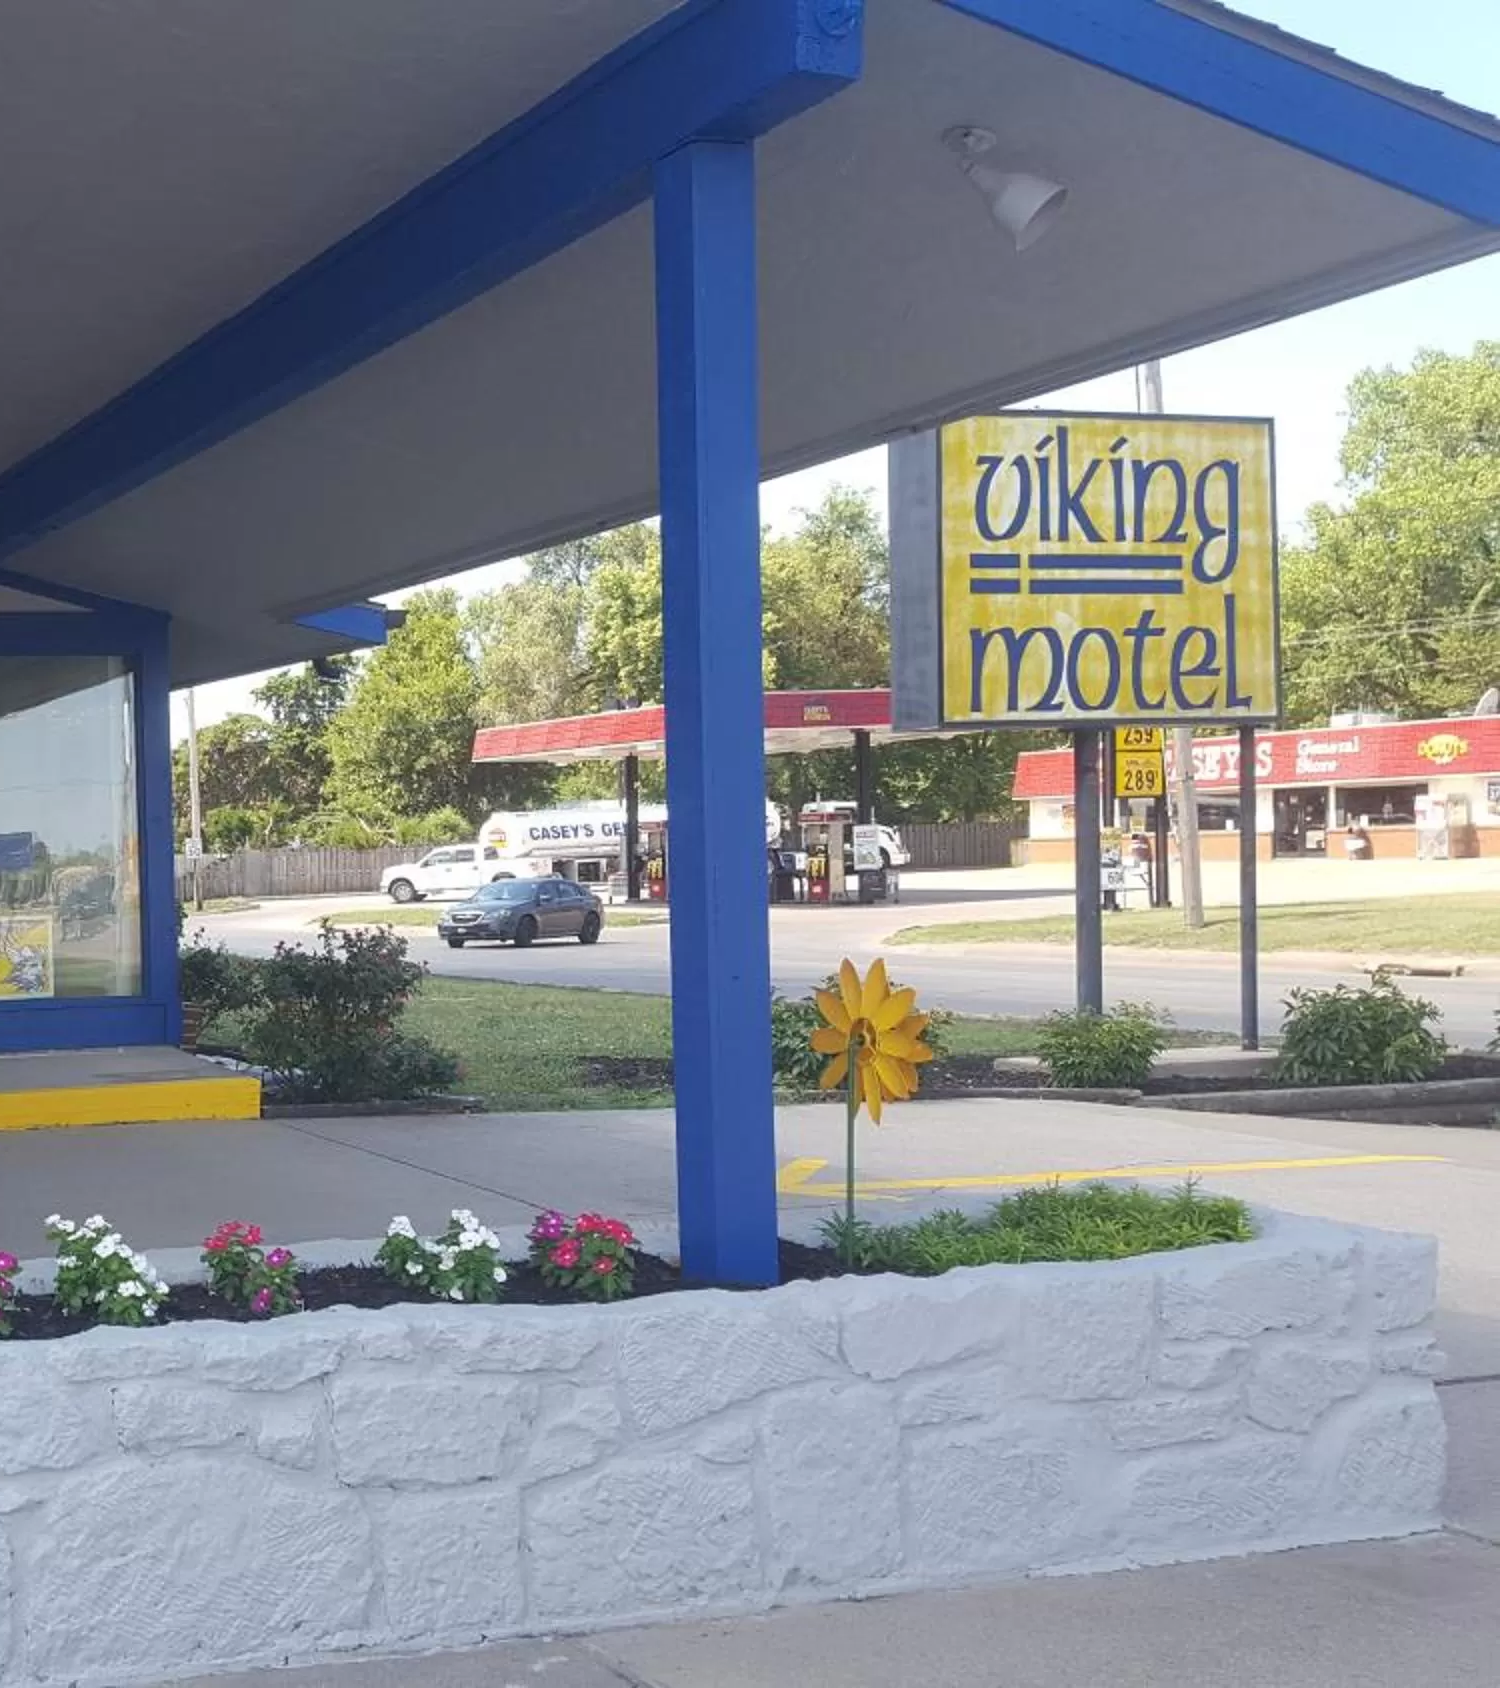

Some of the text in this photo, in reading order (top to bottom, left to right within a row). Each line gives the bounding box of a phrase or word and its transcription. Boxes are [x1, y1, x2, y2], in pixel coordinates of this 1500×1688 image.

[974, 425, 1240, 584] viking
[969, 593, 1253, 712] motel
[1164, 741, 1273, 782] SEYS
[529, 823, 595, 841] CASEY'S
